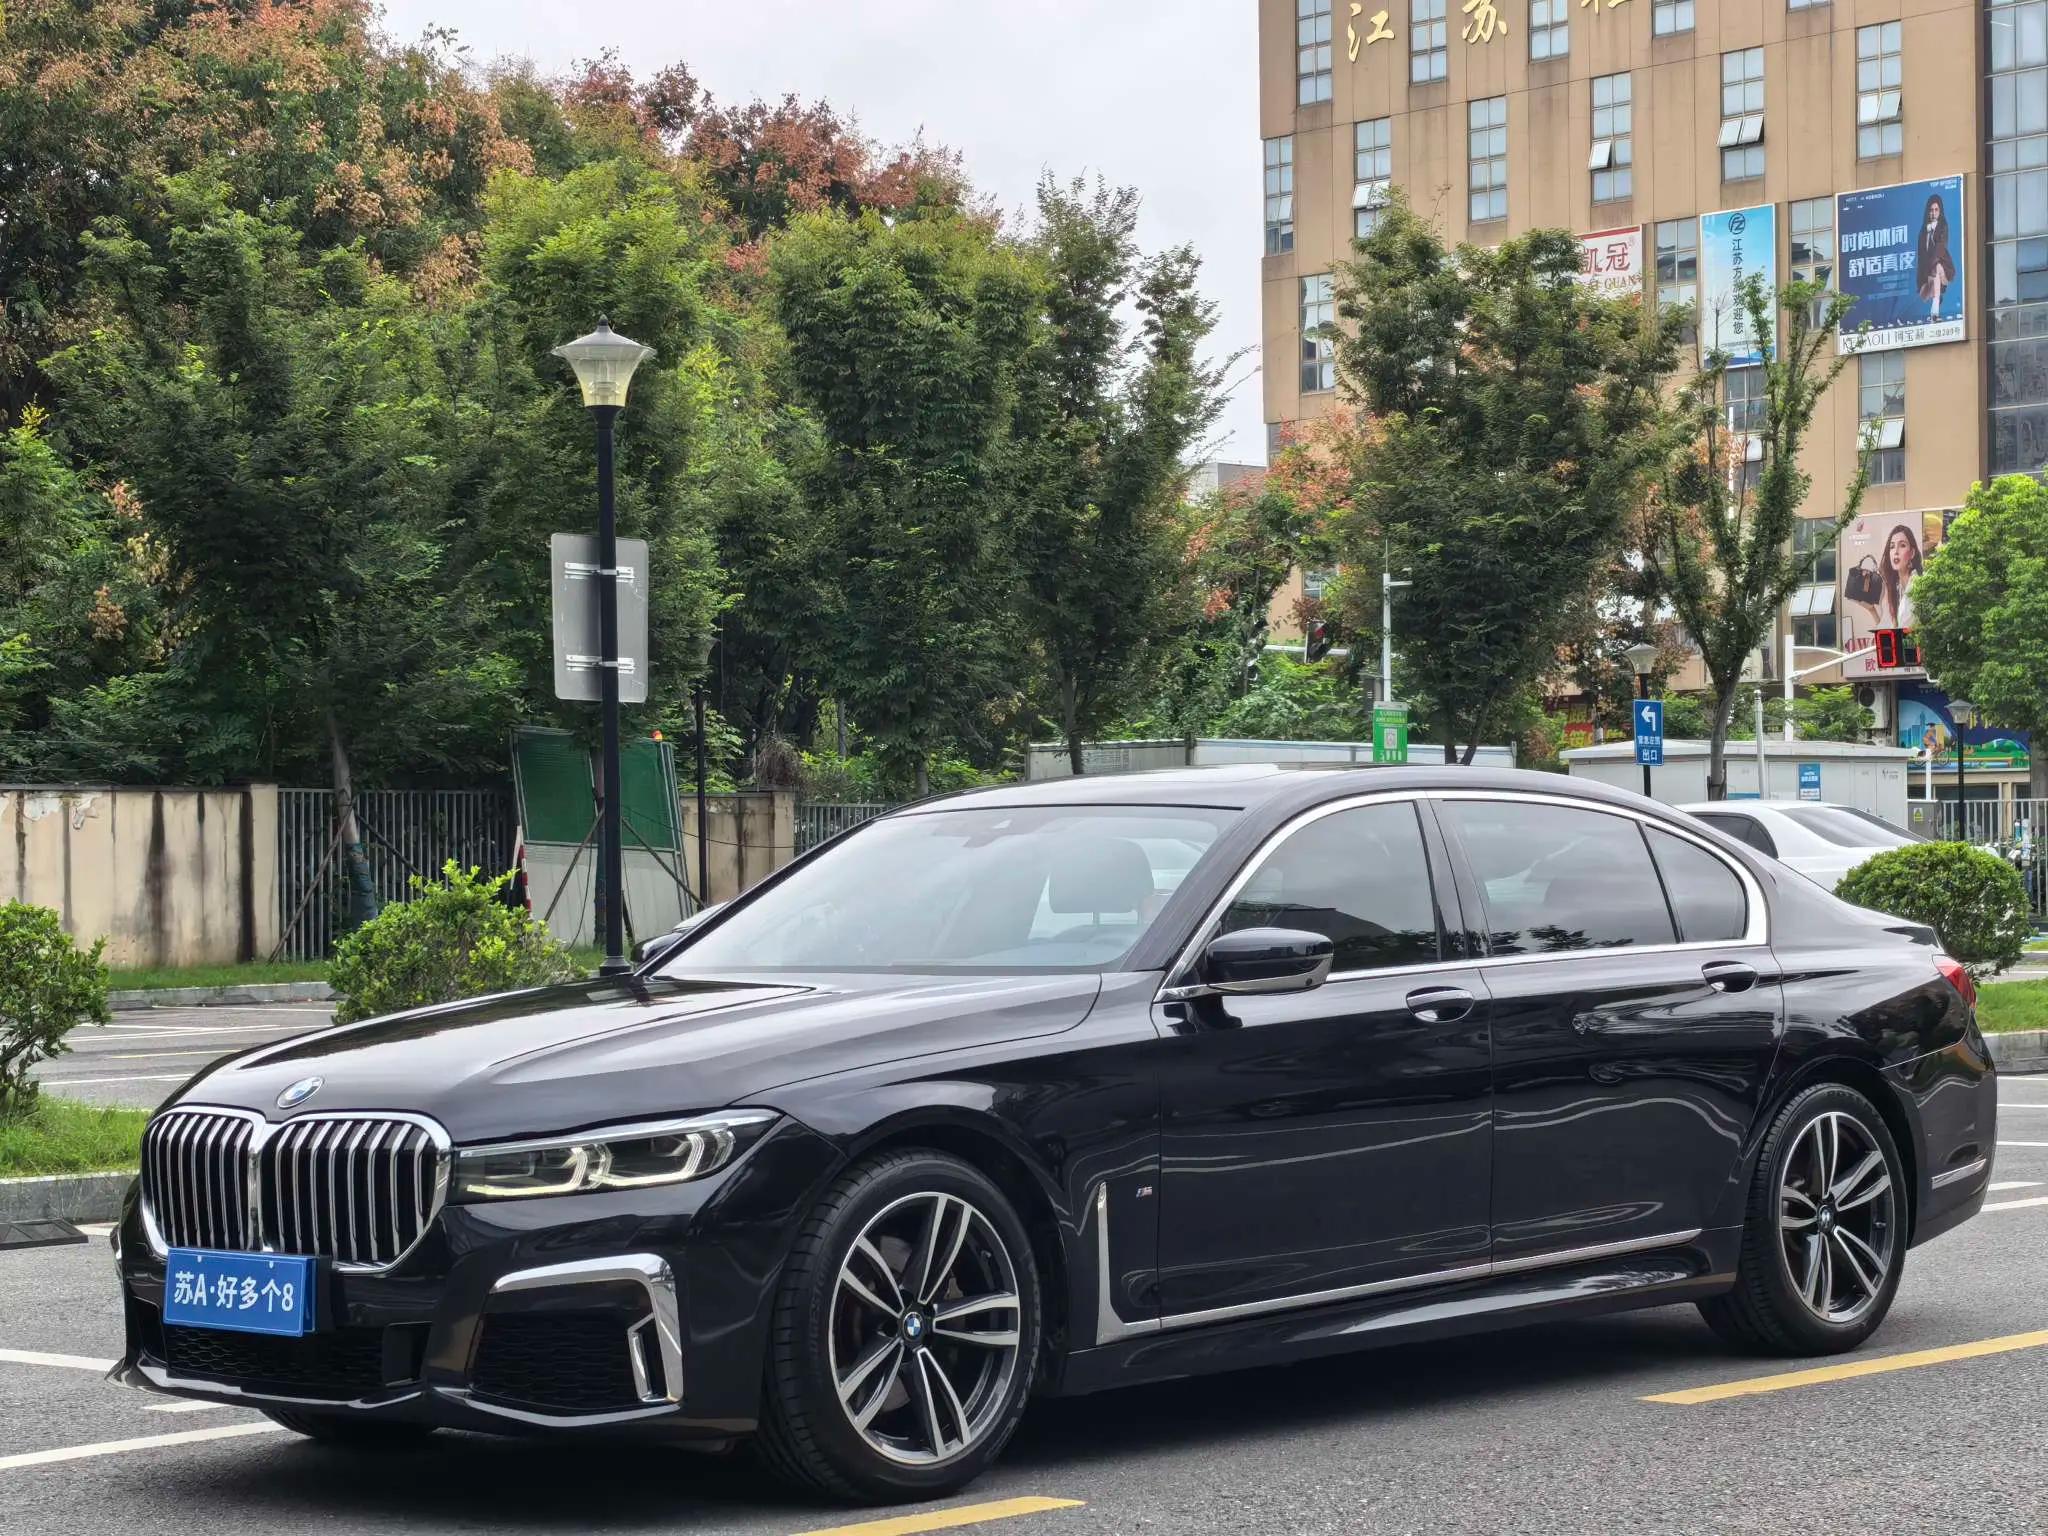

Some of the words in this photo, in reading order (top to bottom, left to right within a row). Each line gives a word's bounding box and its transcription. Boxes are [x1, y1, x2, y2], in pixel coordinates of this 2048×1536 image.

[1841, 224, 1908, 253] 时尚休闲
[1848, 250, 1916, 278] 舒适真皮
[173, 1270, 295, 1313] 苏A·好多个8
